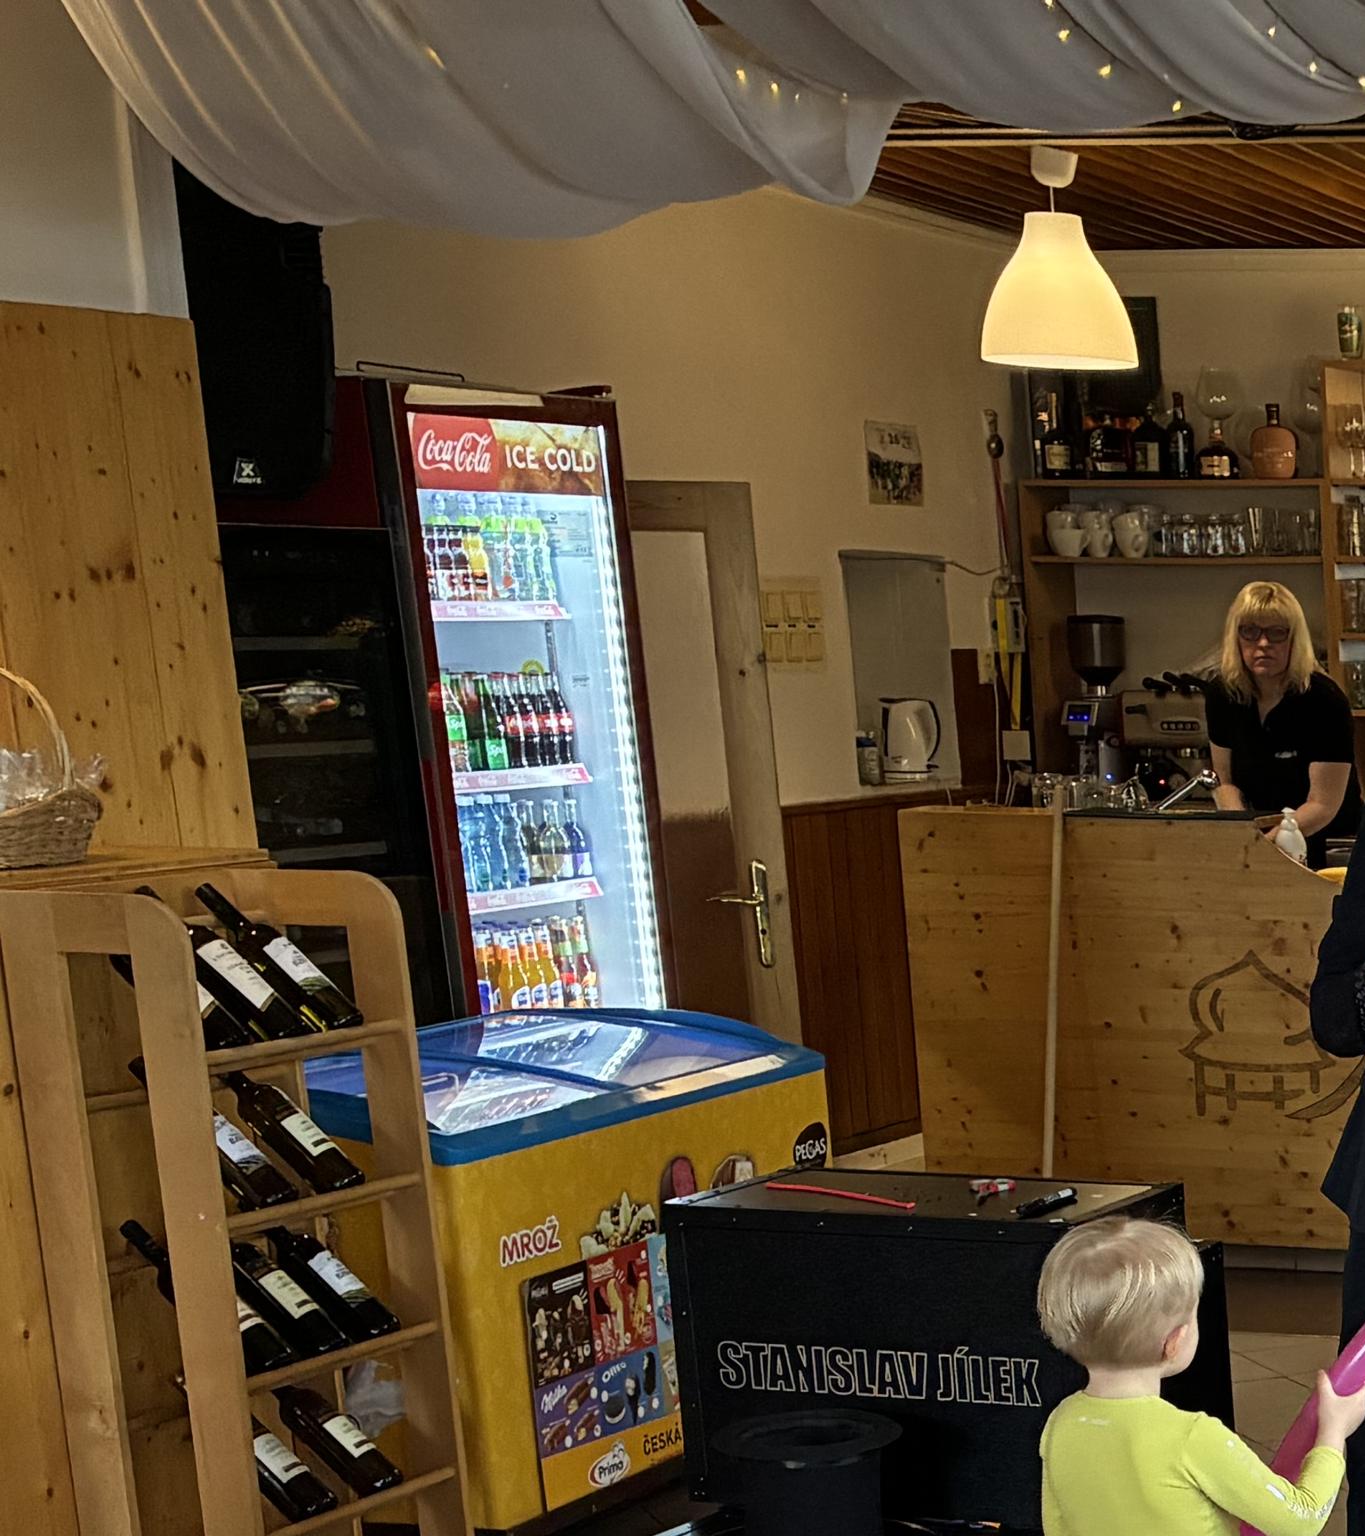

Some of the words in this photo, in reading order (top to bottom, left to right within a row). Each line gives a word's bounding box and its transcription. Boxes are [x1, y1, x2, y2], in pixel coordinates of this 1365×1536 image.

[417, 430, 492, 474] Coca-Cola
[505, 445, 540, 471] ICE
[544, 448, 596, 473] COLD
[795, 1137, 827, 1162] PEGAS
[501, 1215, 562, 1266] MROŽ
[717, 1341, 928, 1400] STANISLAV
[937, 1345, 1043, 1407] JÍLEK
[541, 1384, 568, 1414] Milka
[643, 1423, 682, 1456] ČESKÁ
[598, 1460, 625, 1479] Prima
